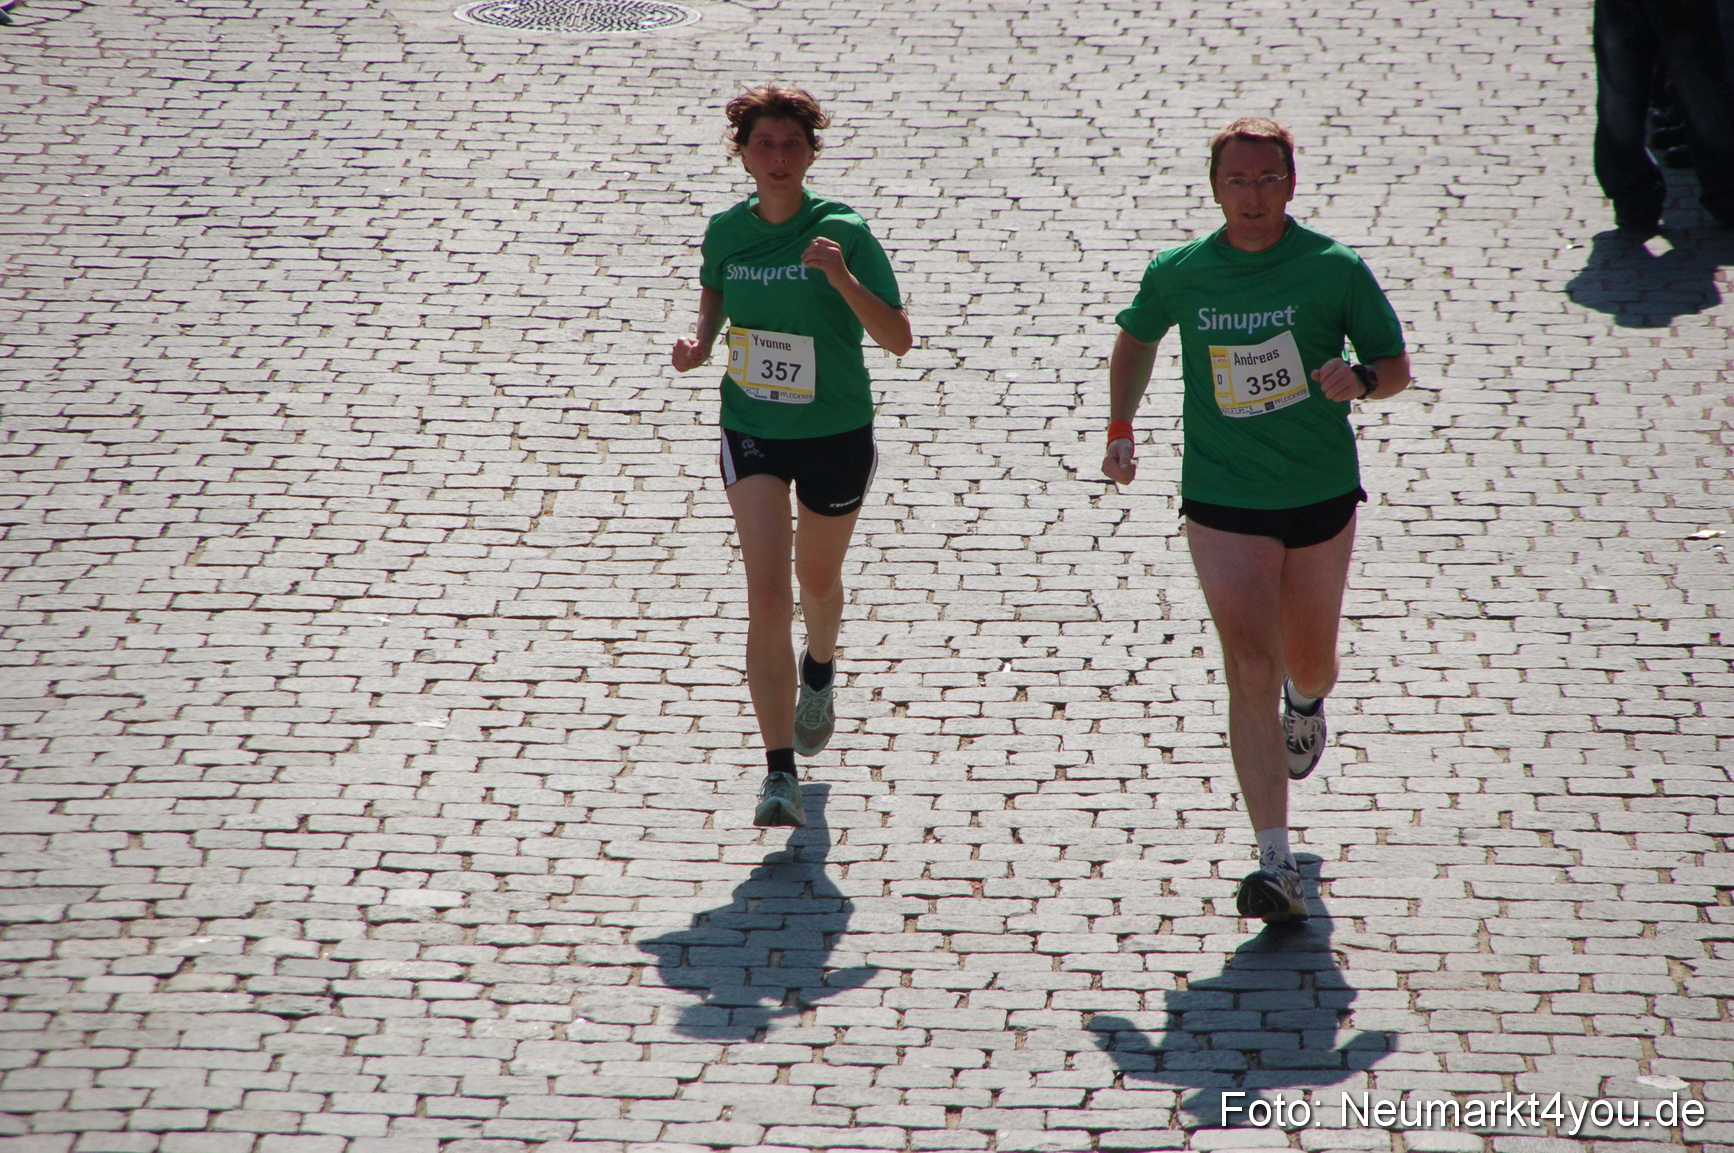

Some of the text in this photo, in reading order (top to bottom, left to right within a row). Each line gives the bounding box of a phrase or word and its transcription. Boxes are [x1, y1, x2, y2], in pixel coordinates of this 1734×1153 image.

[1197, 304, 1296, 335] Sinupret
[752, 333, 792, 351] Yvonne
[1234, 349, 1280, 366] Andreas
[761, 359, 802, 382] 357
[1246, 368, 1291, 395] 358
